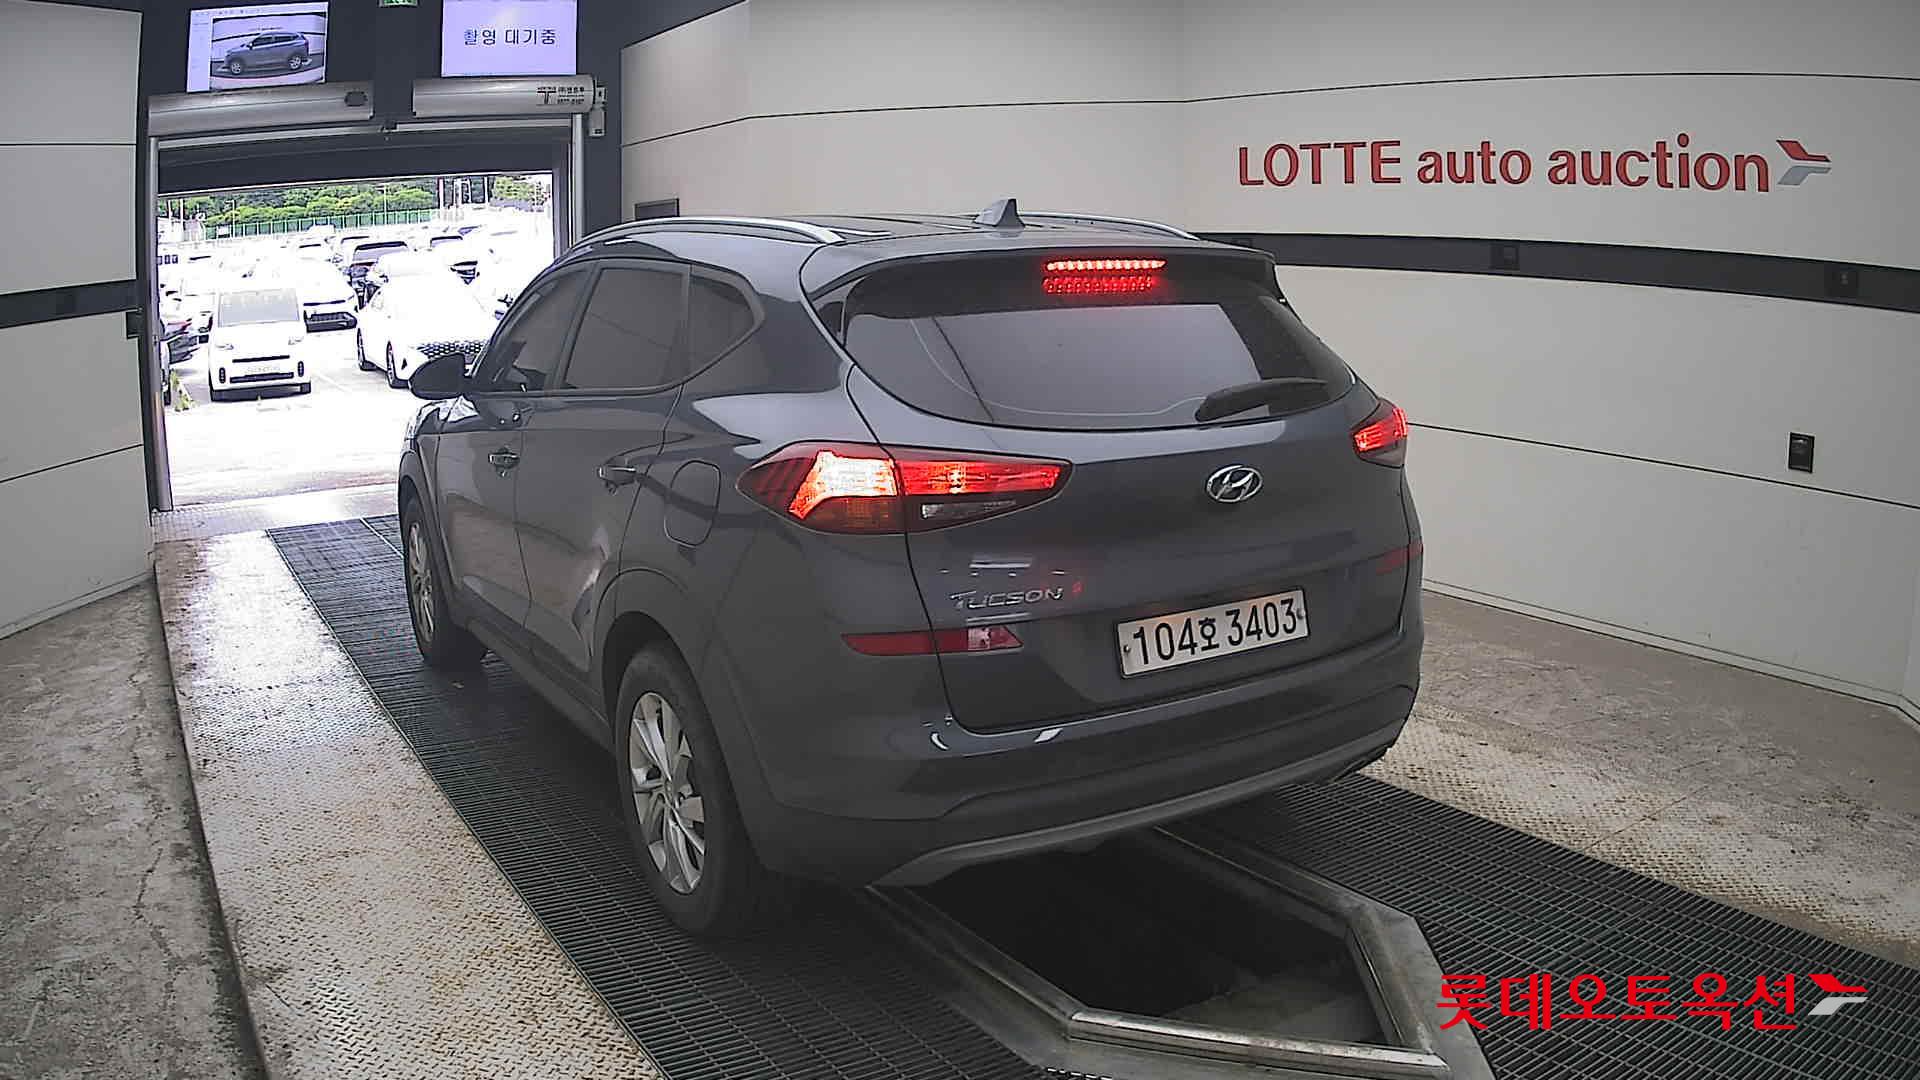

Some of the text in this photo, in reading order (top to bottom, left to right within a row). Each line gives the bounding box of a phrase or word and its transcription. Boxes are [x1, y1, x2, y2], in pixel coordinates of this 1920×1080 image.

[504, 29, 556, 45] 대기중
[1239, 133, 1770, 193] LOTTE auto auction
[950, 587, 1064, 609] TUCSON
[1225, 598, 1297, 646] 3403
